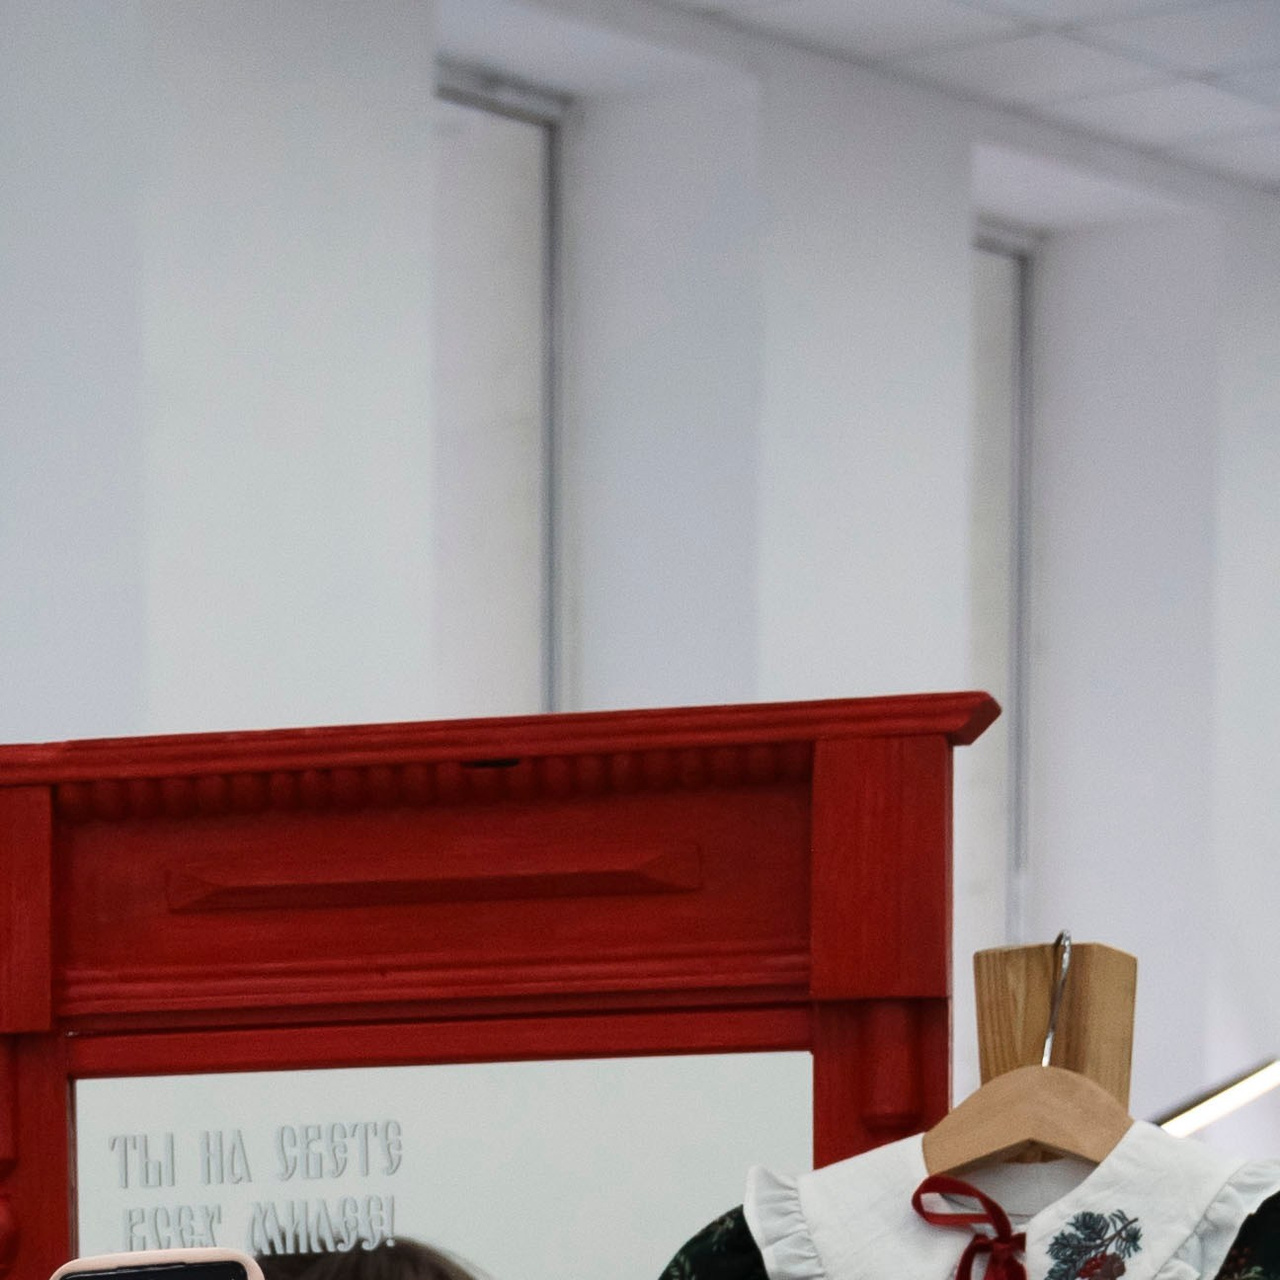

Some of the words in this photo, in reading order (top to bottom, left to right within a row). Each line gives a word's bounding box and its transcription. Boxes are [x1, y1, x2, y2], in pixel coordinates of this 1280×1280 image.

[109, 1133, 175, 1189] ТЫ
[200, 1129, 252, 1184] НА
[277, 1119, 403, 1181] СВЕТЕ
[124, 1203, 222, 1252] ВСЕХ
[247, 1194, 397, 1256] МИЛЕЕ!
